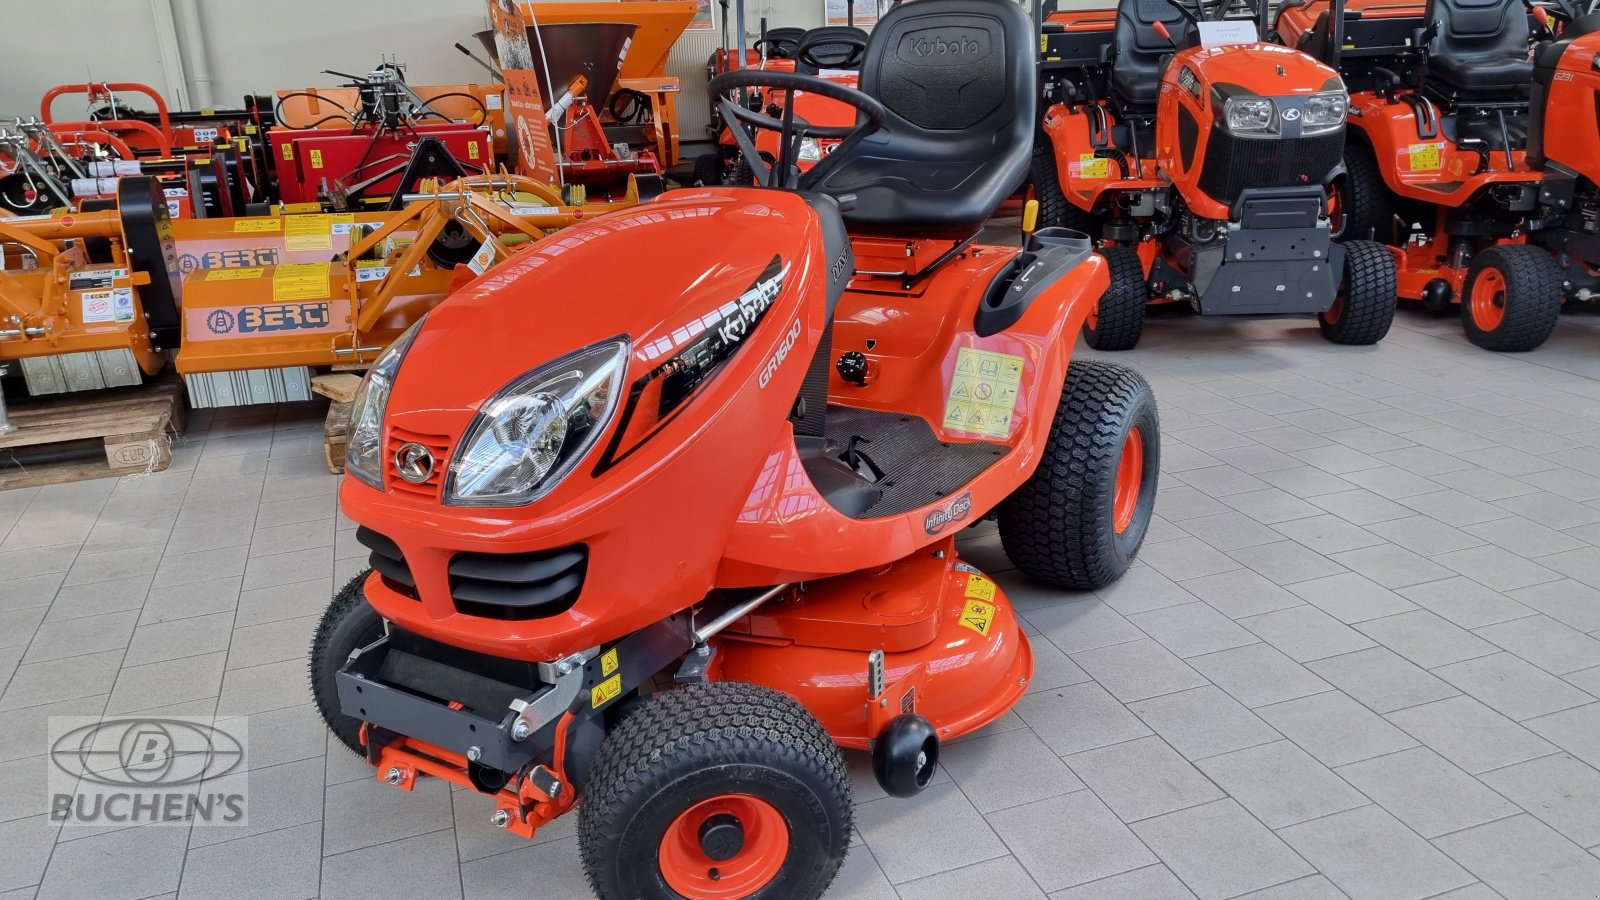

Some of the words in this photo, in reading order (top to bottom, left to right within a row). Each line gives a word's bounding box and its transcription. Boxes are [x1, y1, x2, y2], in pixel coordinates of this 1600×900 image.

[908, 35, 980, 57] Kubota
[758, 317, 801, 390] GR1600
[121, 447, 146, 462] EUR
[925, 505, 953, 530] Infinity
